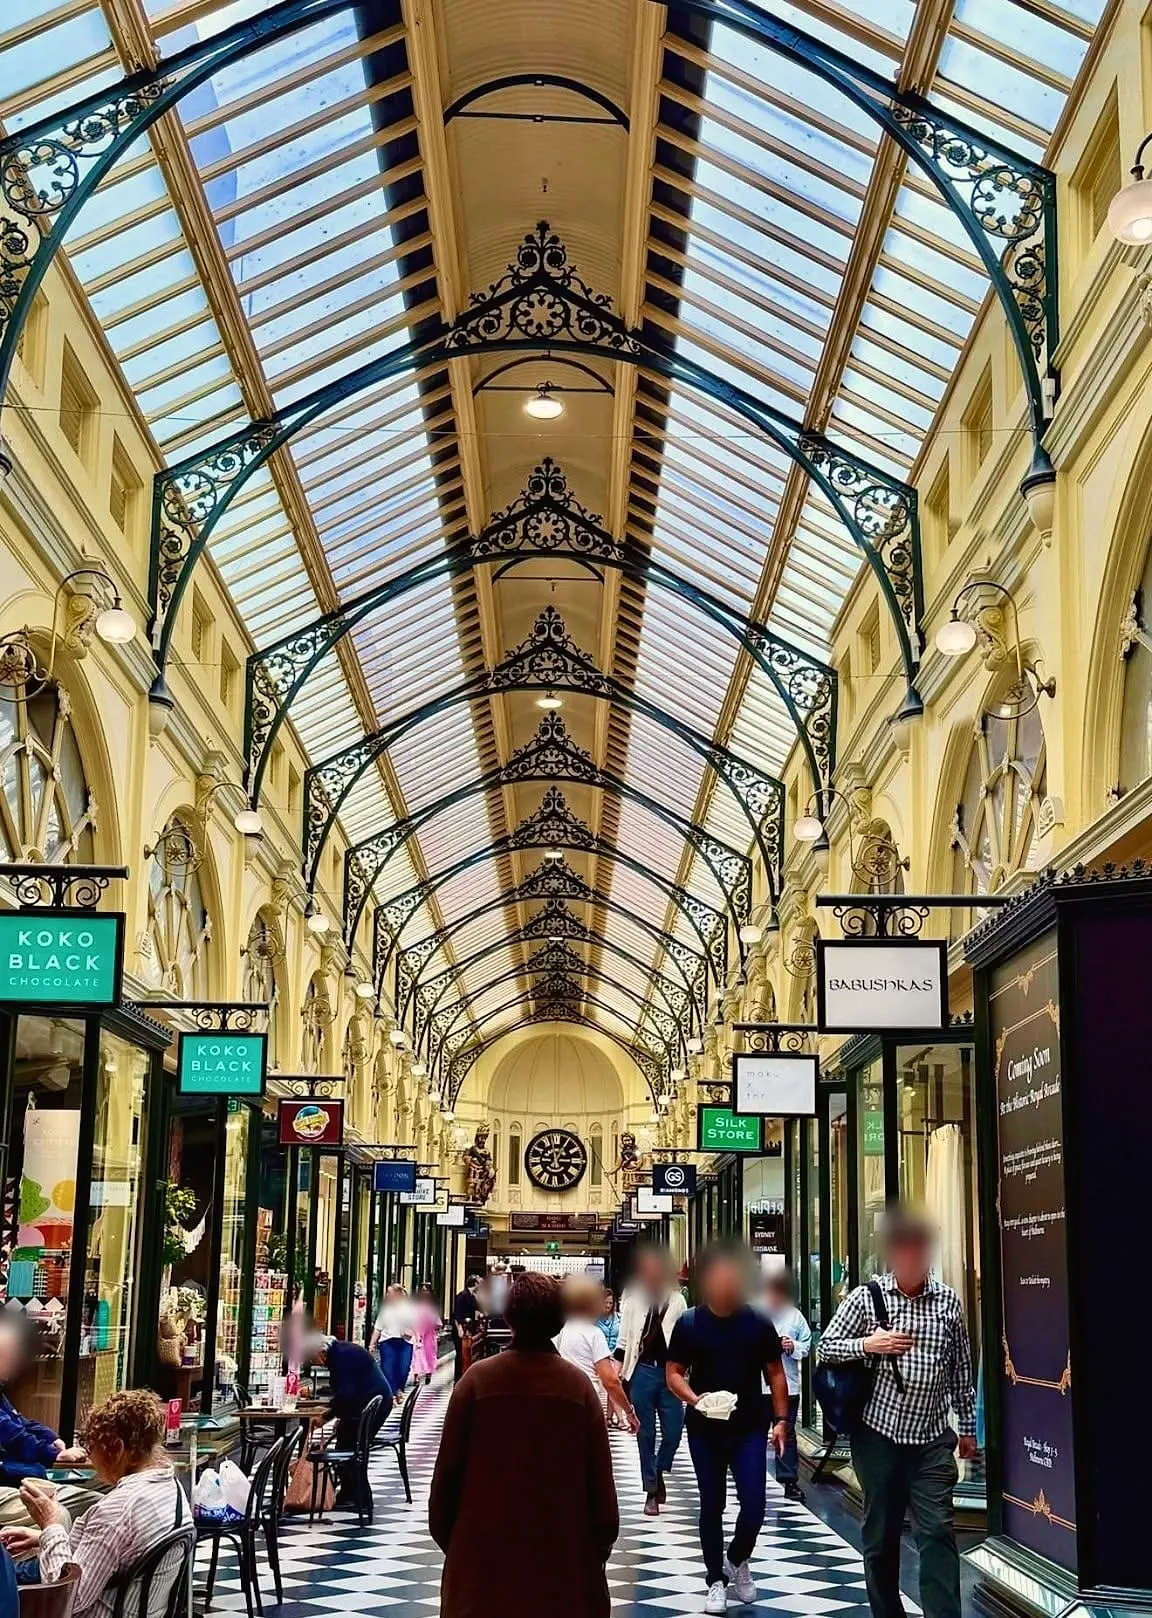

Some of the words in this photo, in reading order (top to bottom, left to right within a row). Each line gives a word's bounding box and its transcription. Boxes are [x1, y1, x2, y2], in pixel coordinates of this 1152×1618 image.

[18, 930, 94, 948] KOKO
[8, 953, 100, 971] BLACK
[9, 977, 100, 987] CHOCOLATE
[828, 977, 934, 992] BABUSHKAS
[197, 1044, 247, 1056] KOKO
[191, 1060, 252, 1072] BLACK
[1007, 1054, 1033, 1084] Coming
[1033, 1047, 1051, 1070] Soon
[715, 1117, 747, 1128] SILK
[707, 1128, 754, 1140] STORE
[667, 1171, 682, 1182] GS
